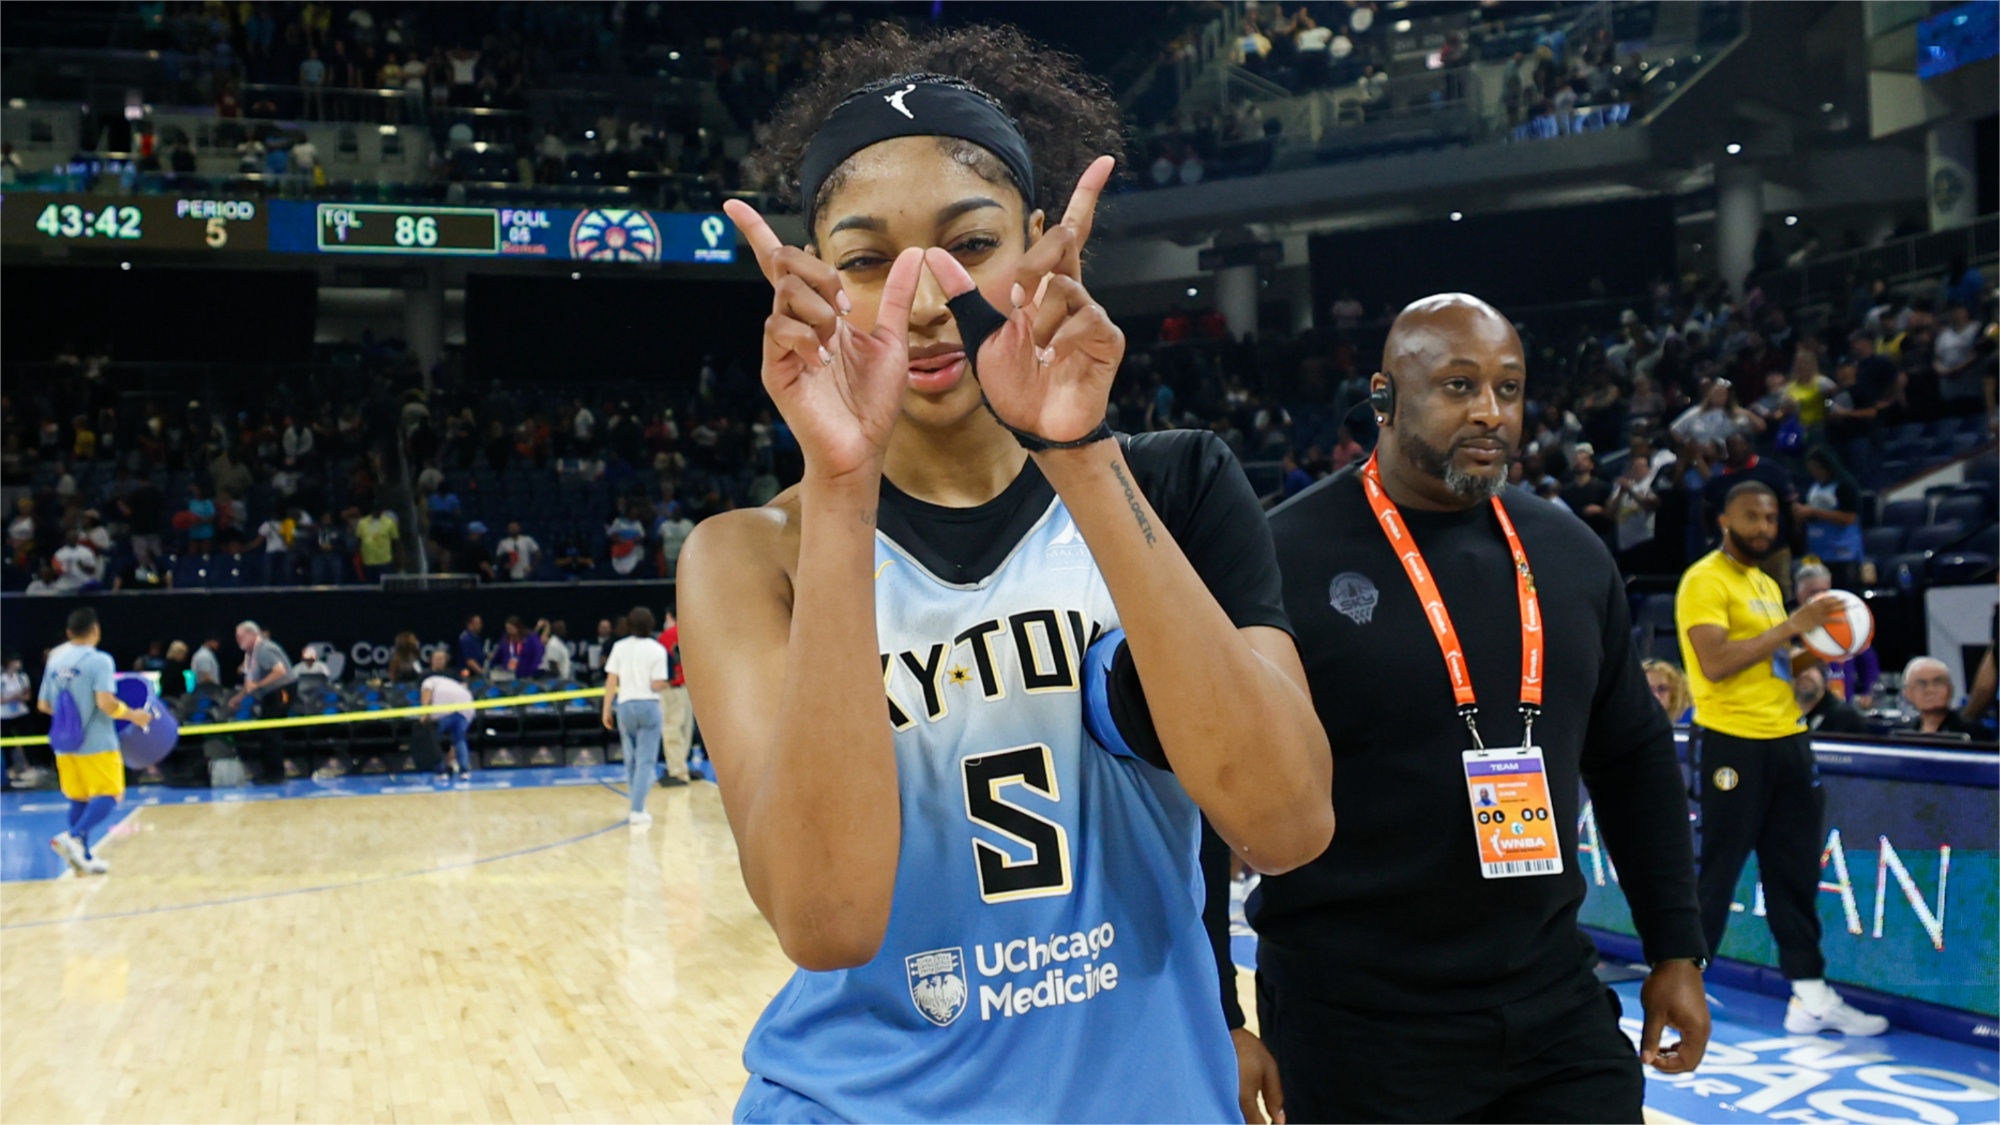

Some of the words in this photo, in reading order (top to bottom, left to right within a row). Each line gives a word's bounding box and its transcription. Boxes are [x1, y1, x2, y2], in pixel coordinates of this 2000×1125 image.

[36, 204, 141, 238] 43:42
[177, 199, 255, 220] PERIOD
[325, 210, 362, 227] TOL
[501, 209, 550, 228] FOUL
[206, 218, 228, 247] 5
[395, 216, 438, 246] 86
[1489, 762, 1520, 772] TEAM
[961, 742, 1073, 904] 5
[1500, 837, 1547, 849] WNBA
[974, 921, 1115, 978] UChicago
[979, 961, 1119, 1021] Medicine
